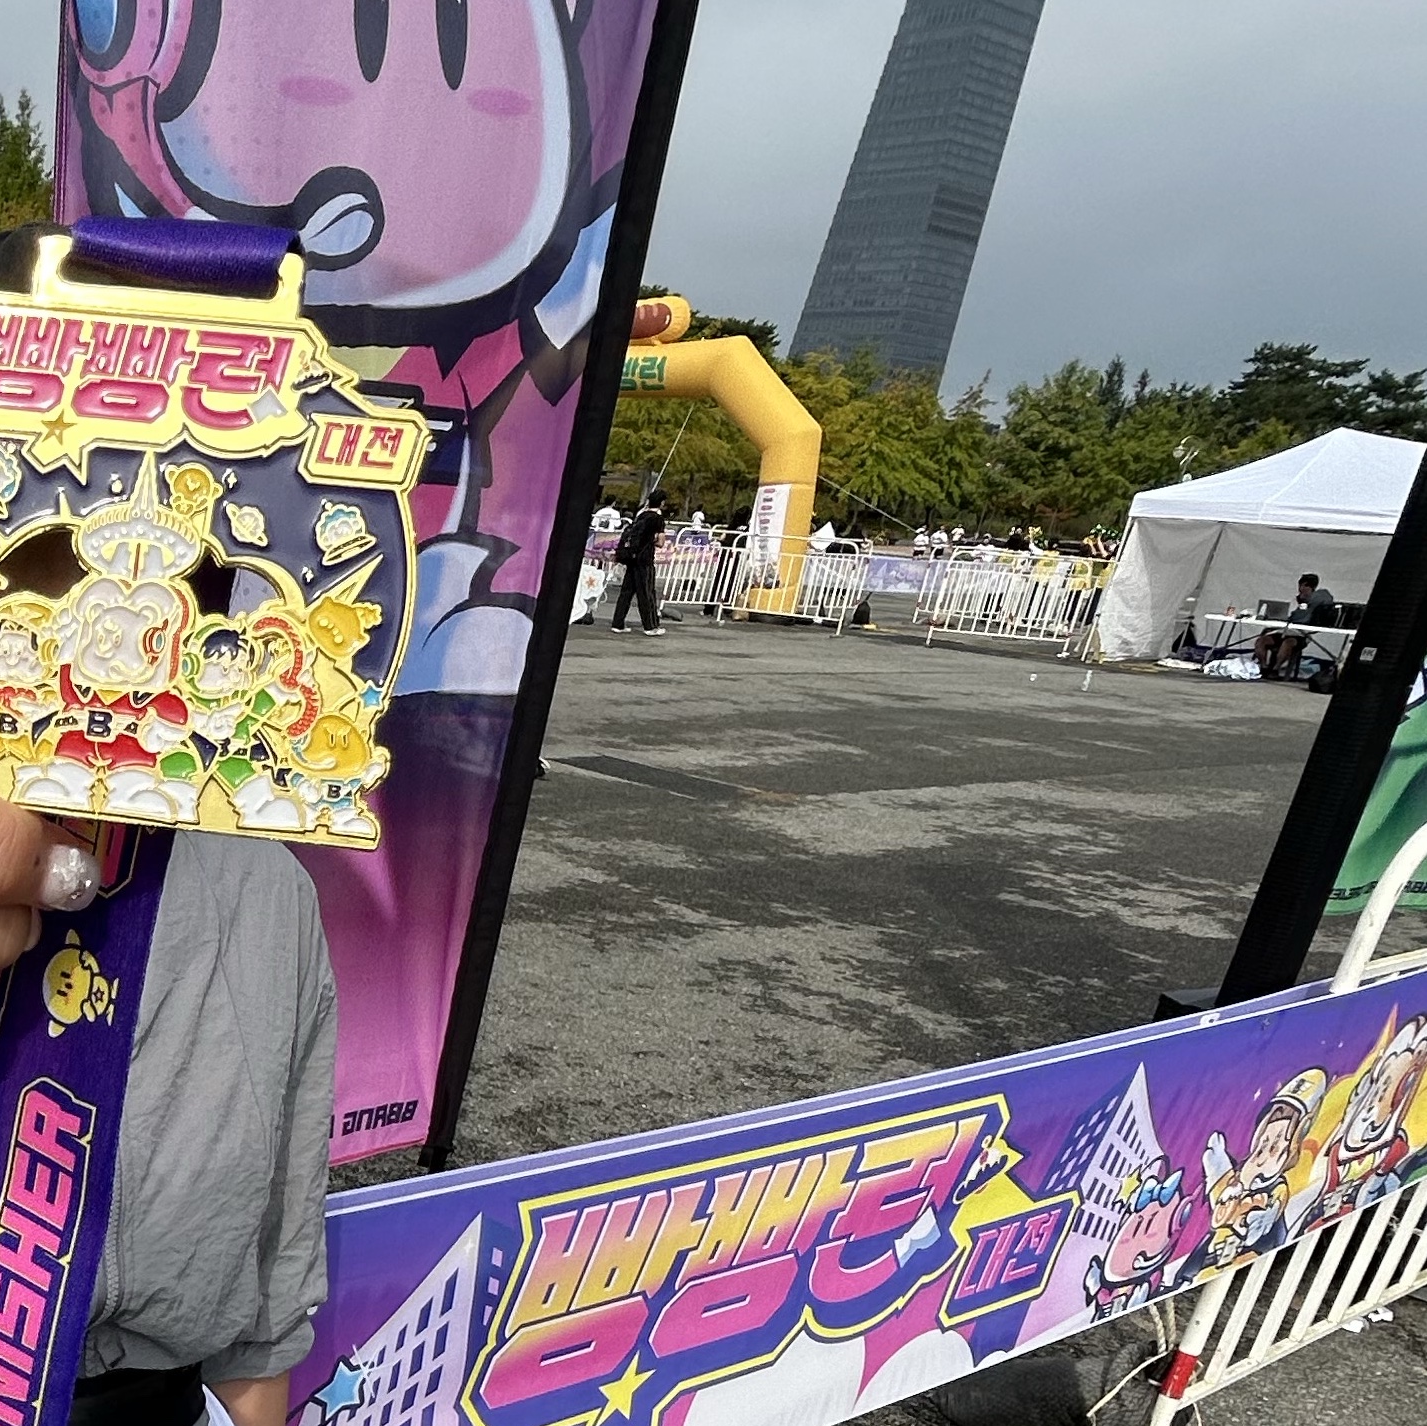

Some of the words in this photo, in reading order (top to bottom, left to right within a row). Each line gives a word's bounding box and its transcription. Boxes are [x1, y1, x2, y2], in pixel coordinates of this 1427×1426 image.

[315, 421, 404, 470] 대전
[87, 710, 113, 738] B
[479, 1113, 986, 1410] 빵빵런
[954, 1208, 1063, 1300] 대전
